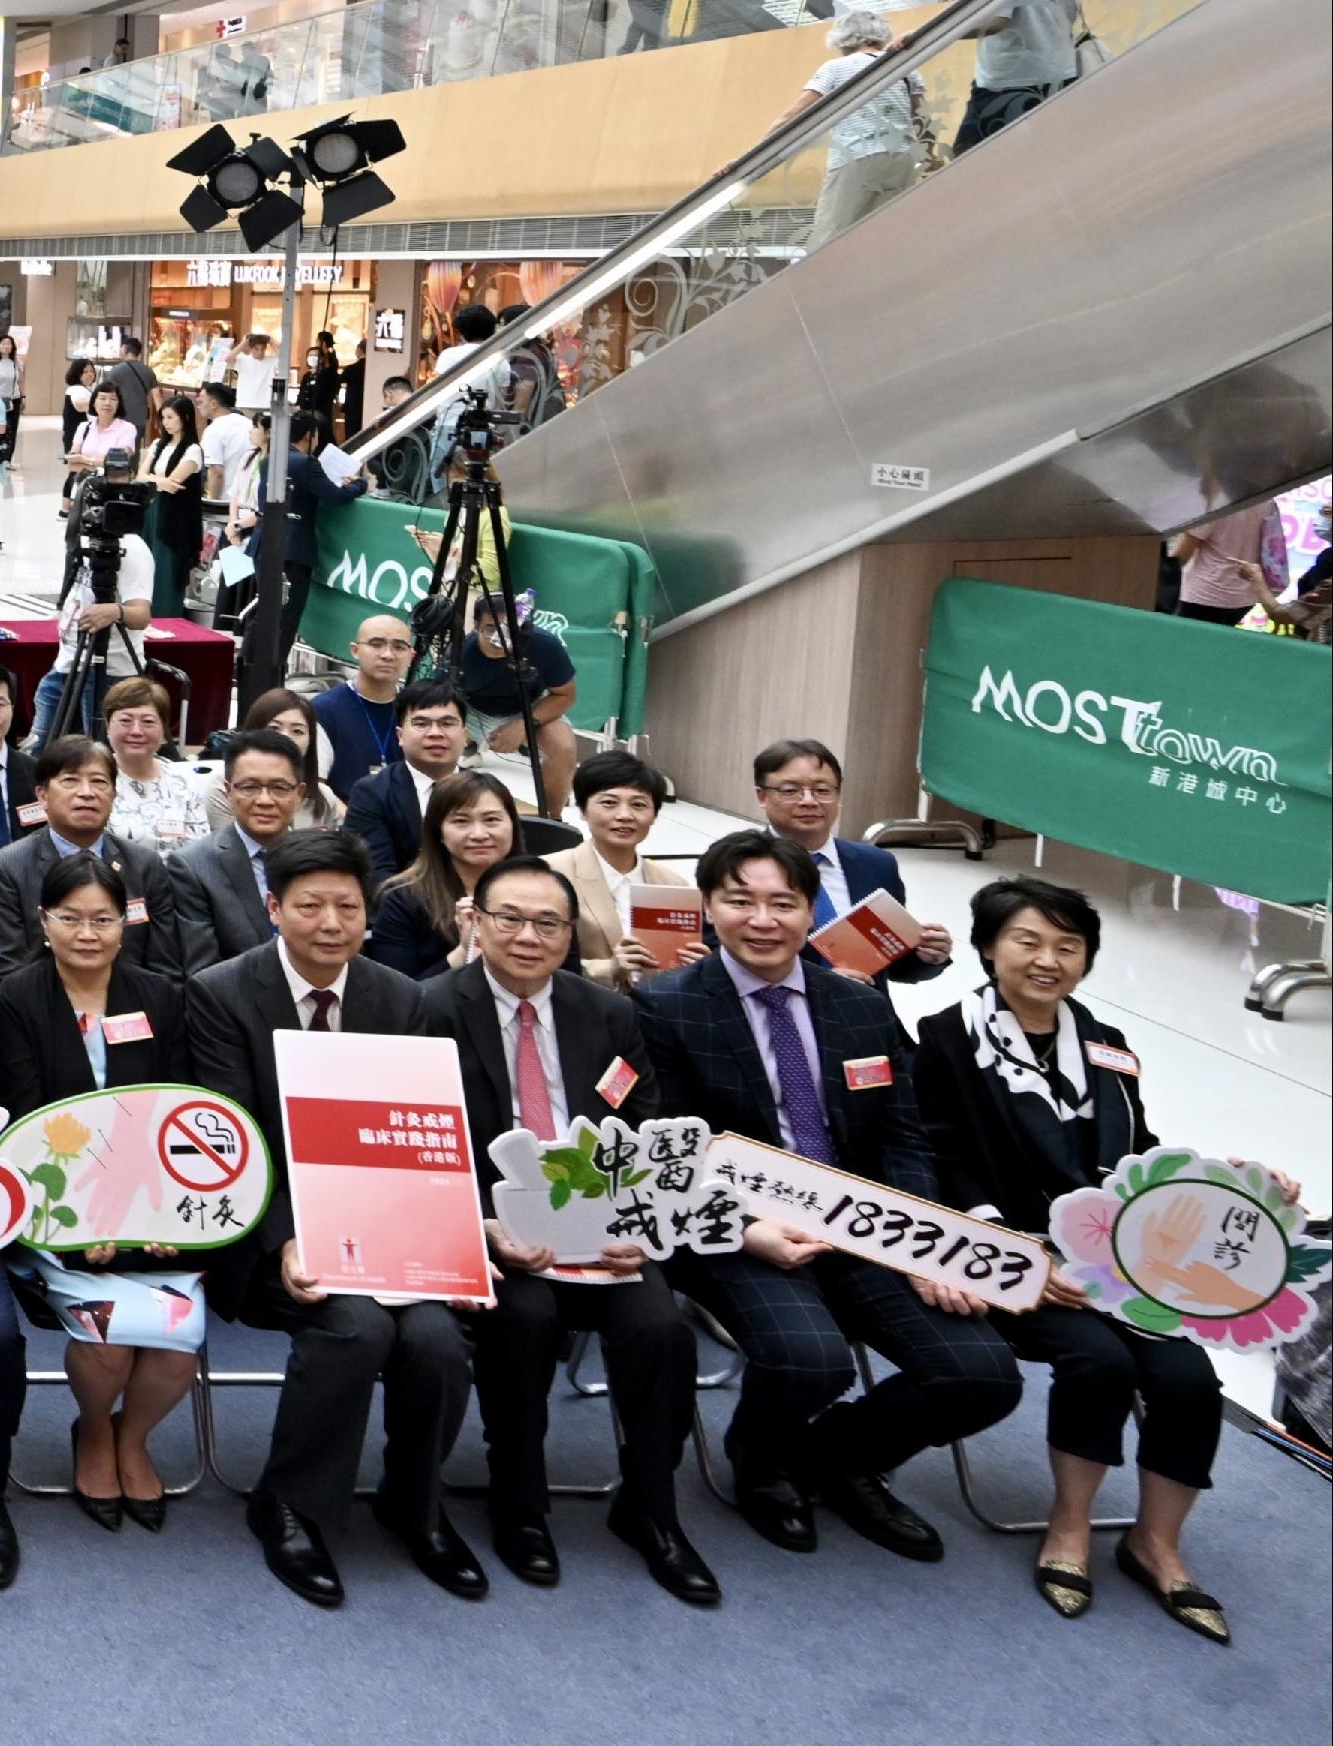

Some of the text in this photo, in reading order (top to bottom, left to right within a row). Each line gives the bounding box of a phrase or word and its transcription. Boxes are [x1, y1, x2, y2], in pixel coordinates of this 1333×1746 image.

[1148, 765, 1287, 815] 新港城中心
[358, 1128, 458, 1150] 臨床實踐指南
[389, 1110, 456, 1130] 針灸戒煙
[417, 1152, 462, 1167] (香港版)
[593, 1127, 702, 1199] 中醫
[176, 1194, 245, 1231] 針灸
[606, 1188, 740, 1252] 戒煙
[715, 1158, 1033, 1292] 戒煙熱線 1833183
[1212, 1206, 1261, 1271] 問診
